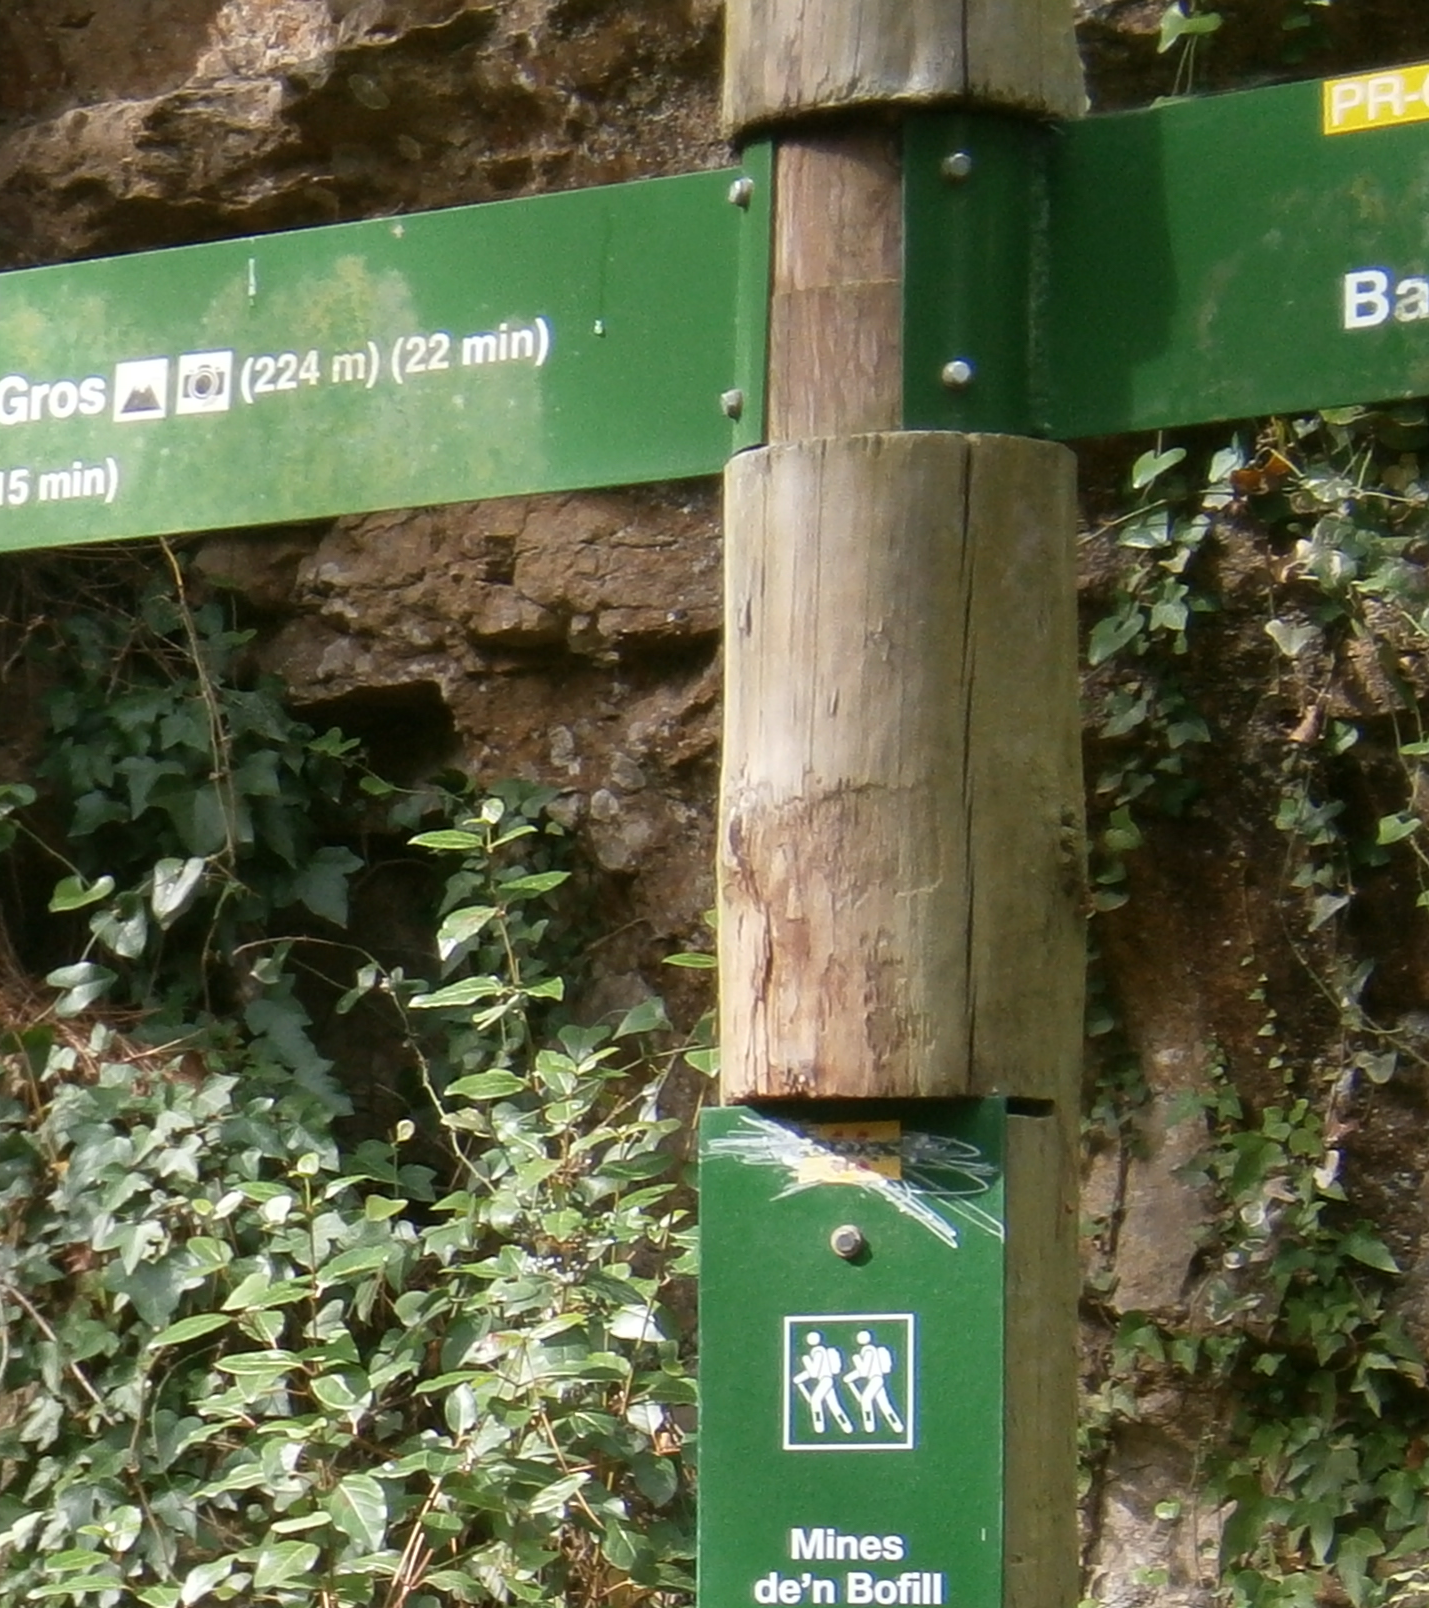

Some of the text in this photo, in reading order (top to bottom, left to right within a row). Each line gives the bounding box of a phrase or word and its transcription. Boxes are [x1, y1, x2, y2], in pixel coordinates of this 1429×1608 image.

[1331, 72, 1429, 127] PR-
[241, 349, 320, 404] (224
[332, 341, 380, 389] m)
[392, 333, 450, 384] (22
[462, 317, 549, 367] min)
[39, 457, 118, 503] min)
[790, 1528, 904, 1560] Mines
[754, 1572, 942, 1605] de'n Bofill
